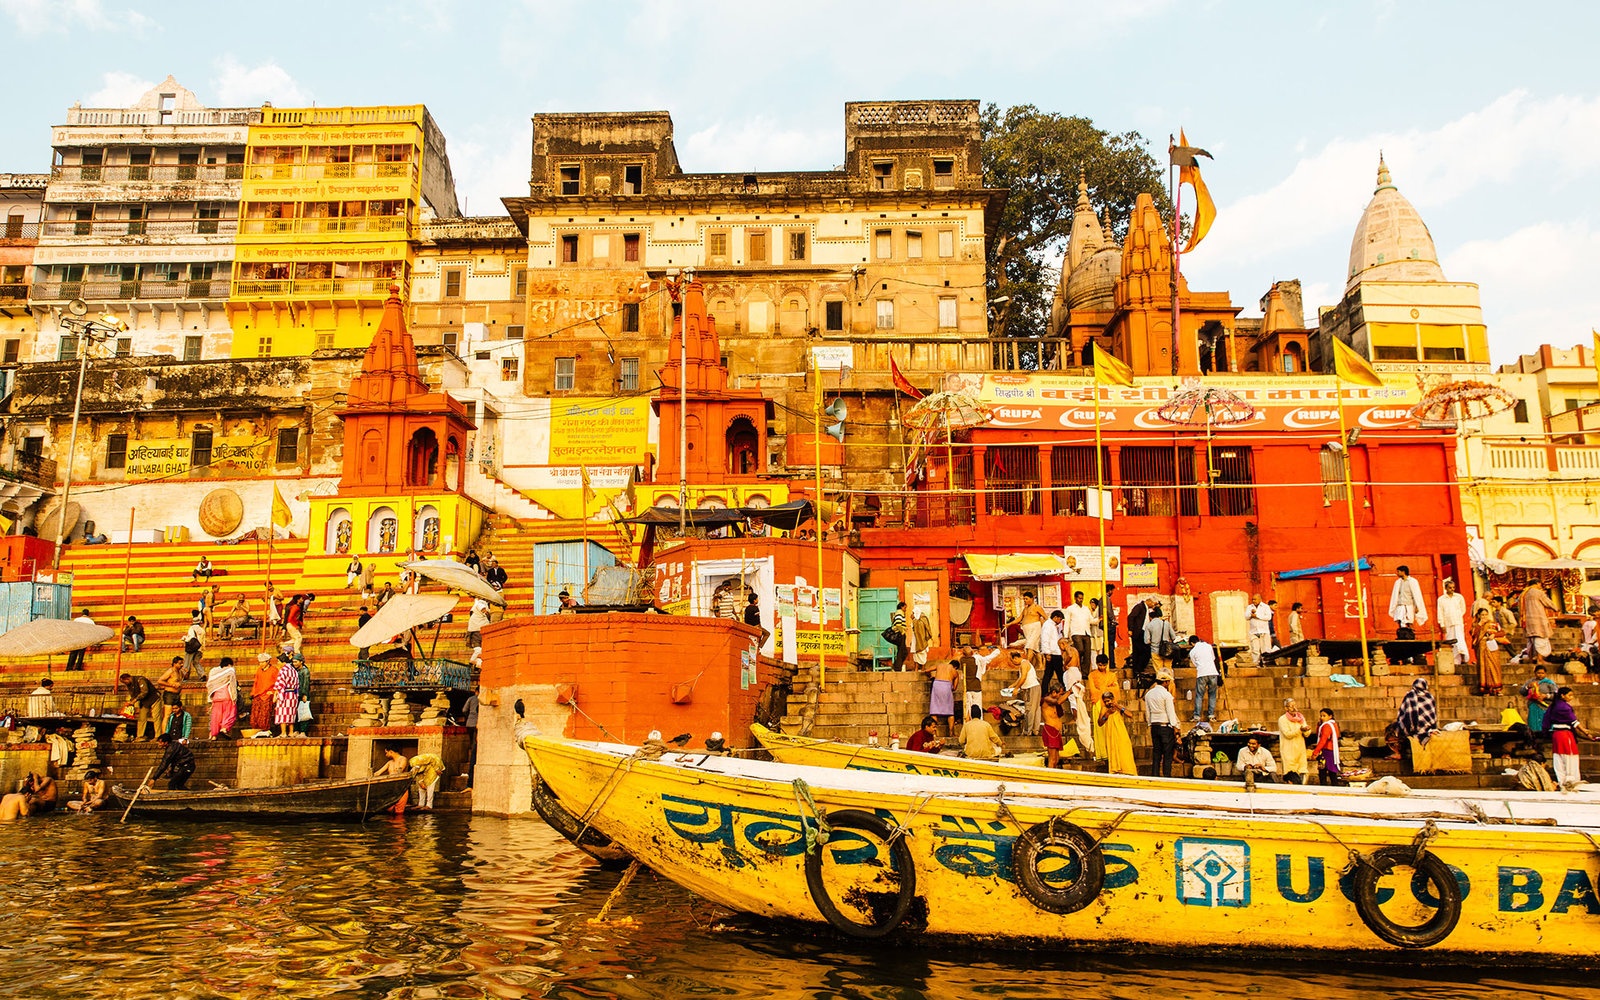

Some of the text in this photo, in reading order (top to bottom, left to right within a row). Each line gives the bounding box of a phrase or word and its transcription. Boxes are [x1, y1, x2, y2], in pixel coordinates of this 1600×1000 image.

[994, 387, 1025, 399] सिद्धपीठ
[1025, 388, 1035, 398] श्री
[999, 408, 1043, 420] RUPA
[1073, 410, 1116, 421] RUPA
[1148, 410, 1190, 421] RUPA
[1297, 410, 1341, 421] RUPA
[127, 445, 190, 460] अहिल्याबाई घाट
[575, 444, 637, 456] इन्टरनेशनल
[126, 462, 188, 475] AHILYABAI GHAT
[549, 467, 558, 477] श्री
[559, 467, 568, 477] श्री
[1274, 853, 1471, 908] UCO
